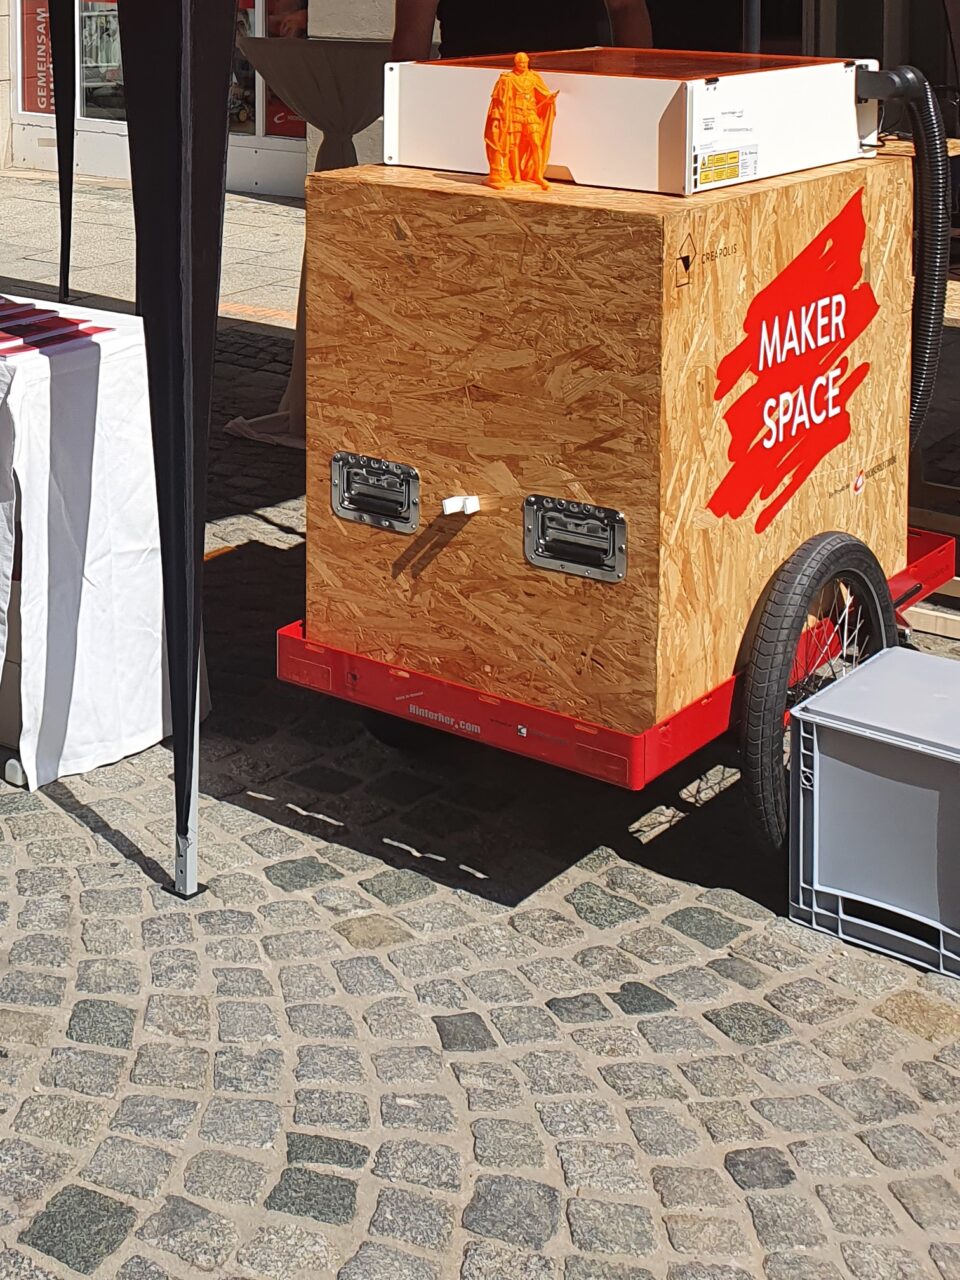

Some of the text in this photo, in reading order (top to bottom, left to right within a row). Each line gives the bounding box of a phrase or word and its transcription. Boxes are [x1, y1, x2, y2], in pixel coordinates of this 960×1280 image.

[37, 7, 47, 109] GEMEINSAM
[701, 244, 738, 264] CREAPOLIS
[758, 294, 847, 371] MAKER
[762, 368, 842, 449] SPACE
[409, 703, 481, 734] Hinterher.com
